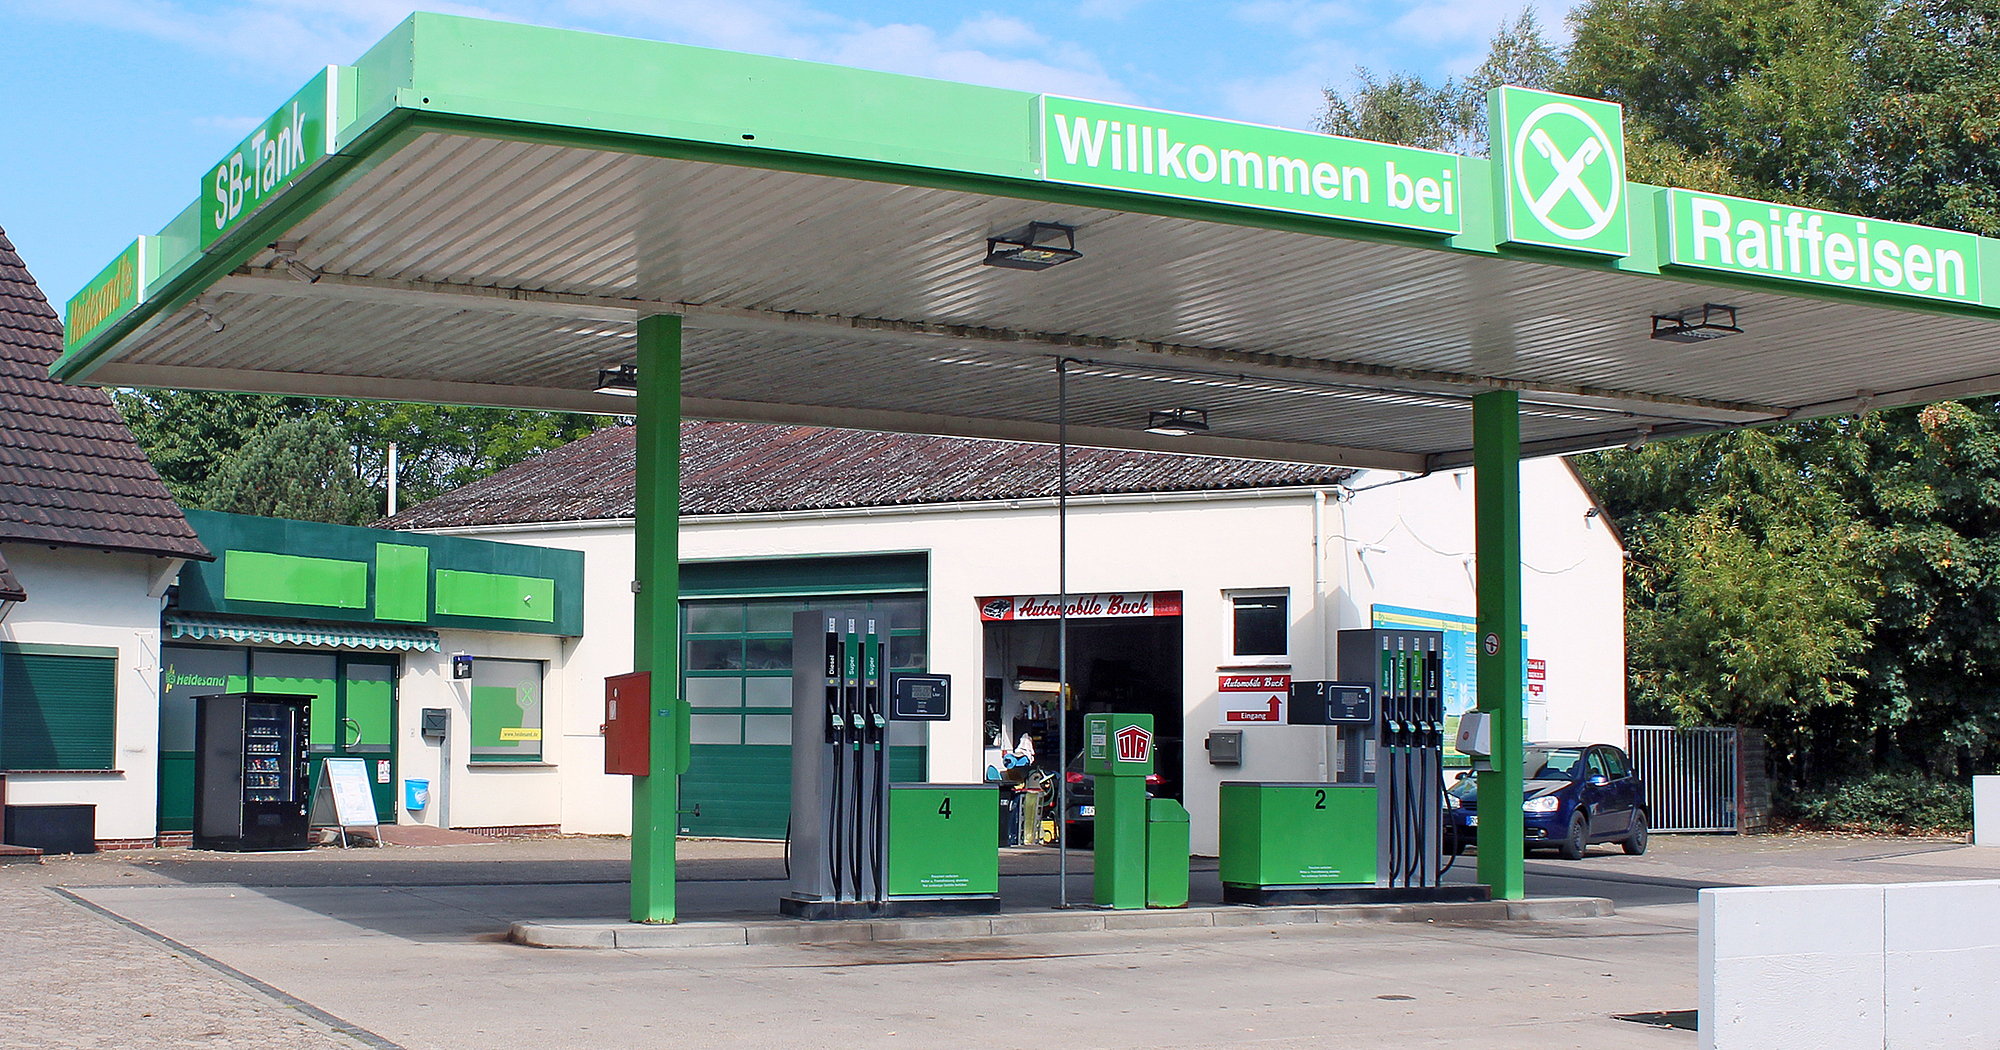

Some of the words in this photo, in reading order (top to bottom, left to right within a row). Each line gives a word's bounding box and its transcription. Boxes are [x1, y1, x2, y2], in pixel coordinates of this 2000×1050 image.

[214, 100, 306, 230] SB-Tank
[1053, 113, 1370, 204] Willkommen
[1385, 161, 1453, 215] bei
[1690, 196, 1966, 297] Raiffeisen
[1107, 593, 1149, 615] Buck
[848, 655, 856, 675] Super
[868, 656, 876, 676] Super
[176, 673, 226, 687] Heidesand
[1222, 676, 1262, 688] Automobile
[1264, 676, 1284, 688] Buck
[1290, 684, 1296, 697] 1
[1317, 682, 1324, 695] 2
[1240, 712, 1267, 721] Eingang
[1118, 729, 1149, 759] UTA
[938, 797, 952, 819] 4
[1314, 788, 1327, 810] 2
